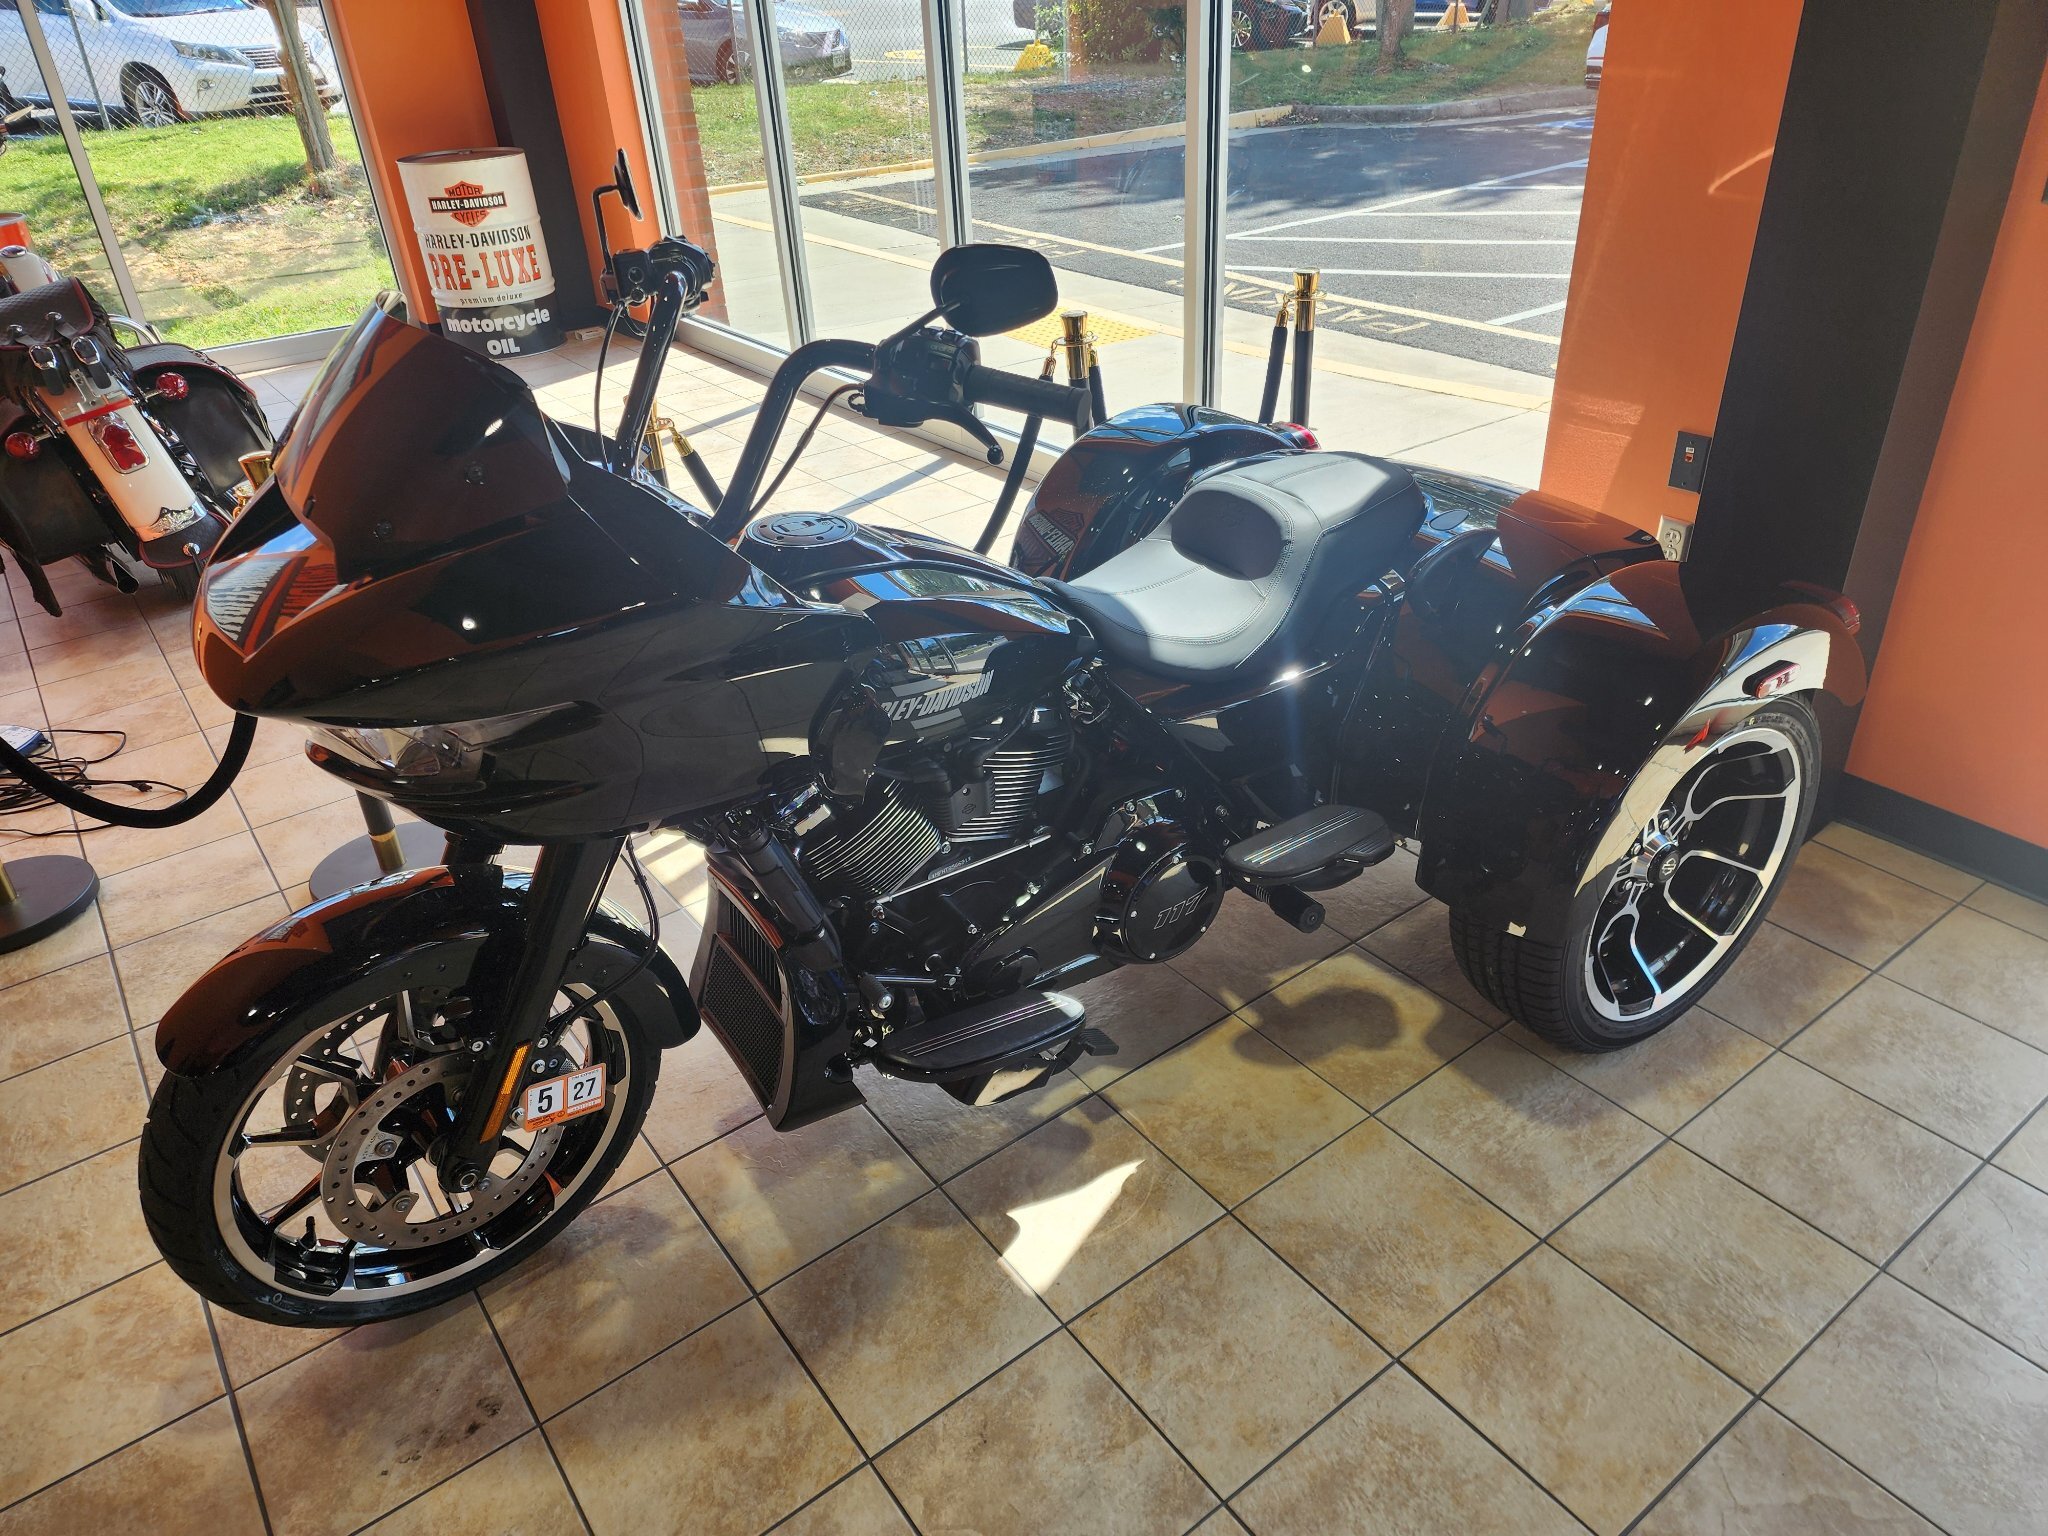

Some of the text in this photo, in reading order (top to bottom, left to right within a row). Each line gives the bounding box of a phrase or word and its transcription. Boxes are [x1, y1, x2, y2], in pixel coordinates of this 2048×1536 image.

[431, 195, 504, 211] HARLEY-DAVIDSON
[448, 184, 482, 197] MOTOR
[453, 209, 488, 226] CYCLES
[424, 224, 531, 250] HARLEY-DAVIDSON
[428, 244, 542, 291] PRE-LUXE
[460, 291, 523, 306] premium deluxe
[446, 307, 550, 334] motorcycle
[486, 337, 520, 356] OIL
[881, 669, 995, 722] RLEY-DAVIDSON
[1153, 886, 1209, 931] 117
[537, 1086, 553, 1114] 5
[573, 1077, 597, 1101] 27
